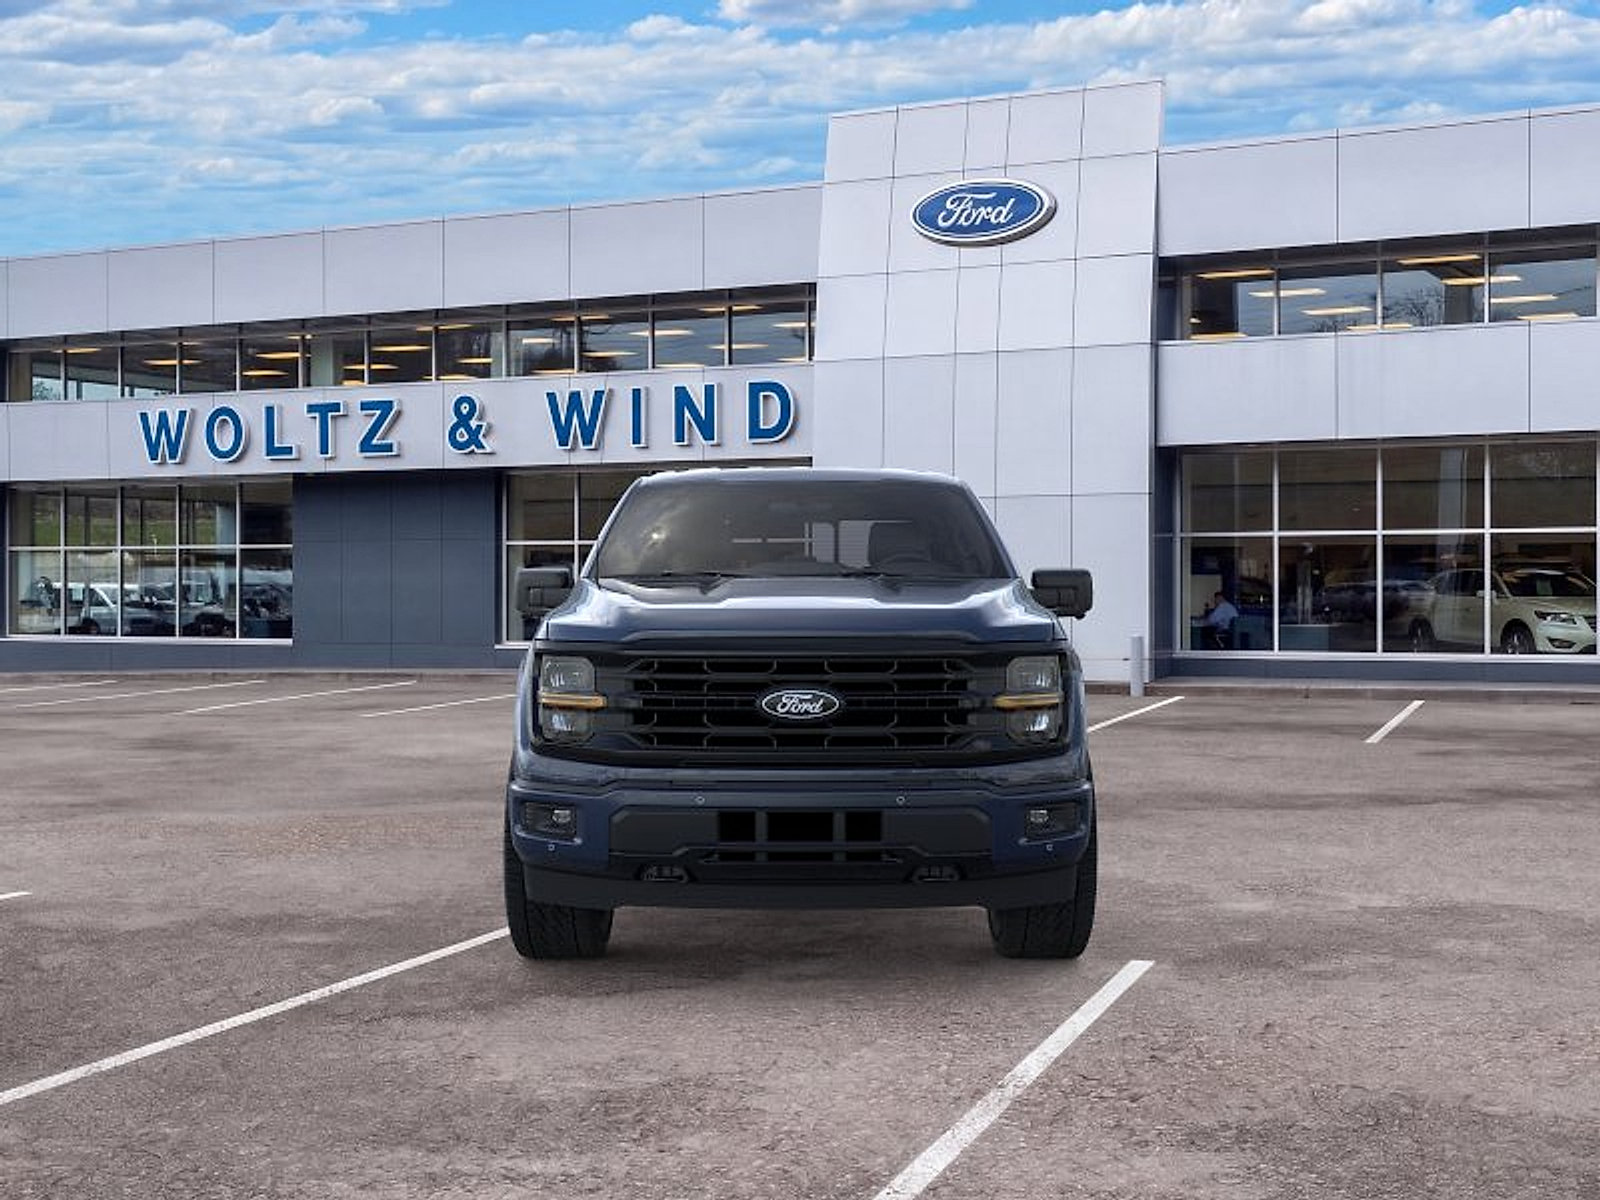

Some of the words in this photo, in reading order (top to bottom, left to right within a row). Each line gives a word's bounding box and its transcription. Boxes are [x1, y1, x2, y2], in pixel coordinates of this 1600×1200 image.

[937, 192, 1015, 227] Ford
[138, 398, 400, 464] WOLTZ
[447, 395, 492, 454] &
[545, 380, 795, 450] WIND
[776, 694, 824, 713] Ford
